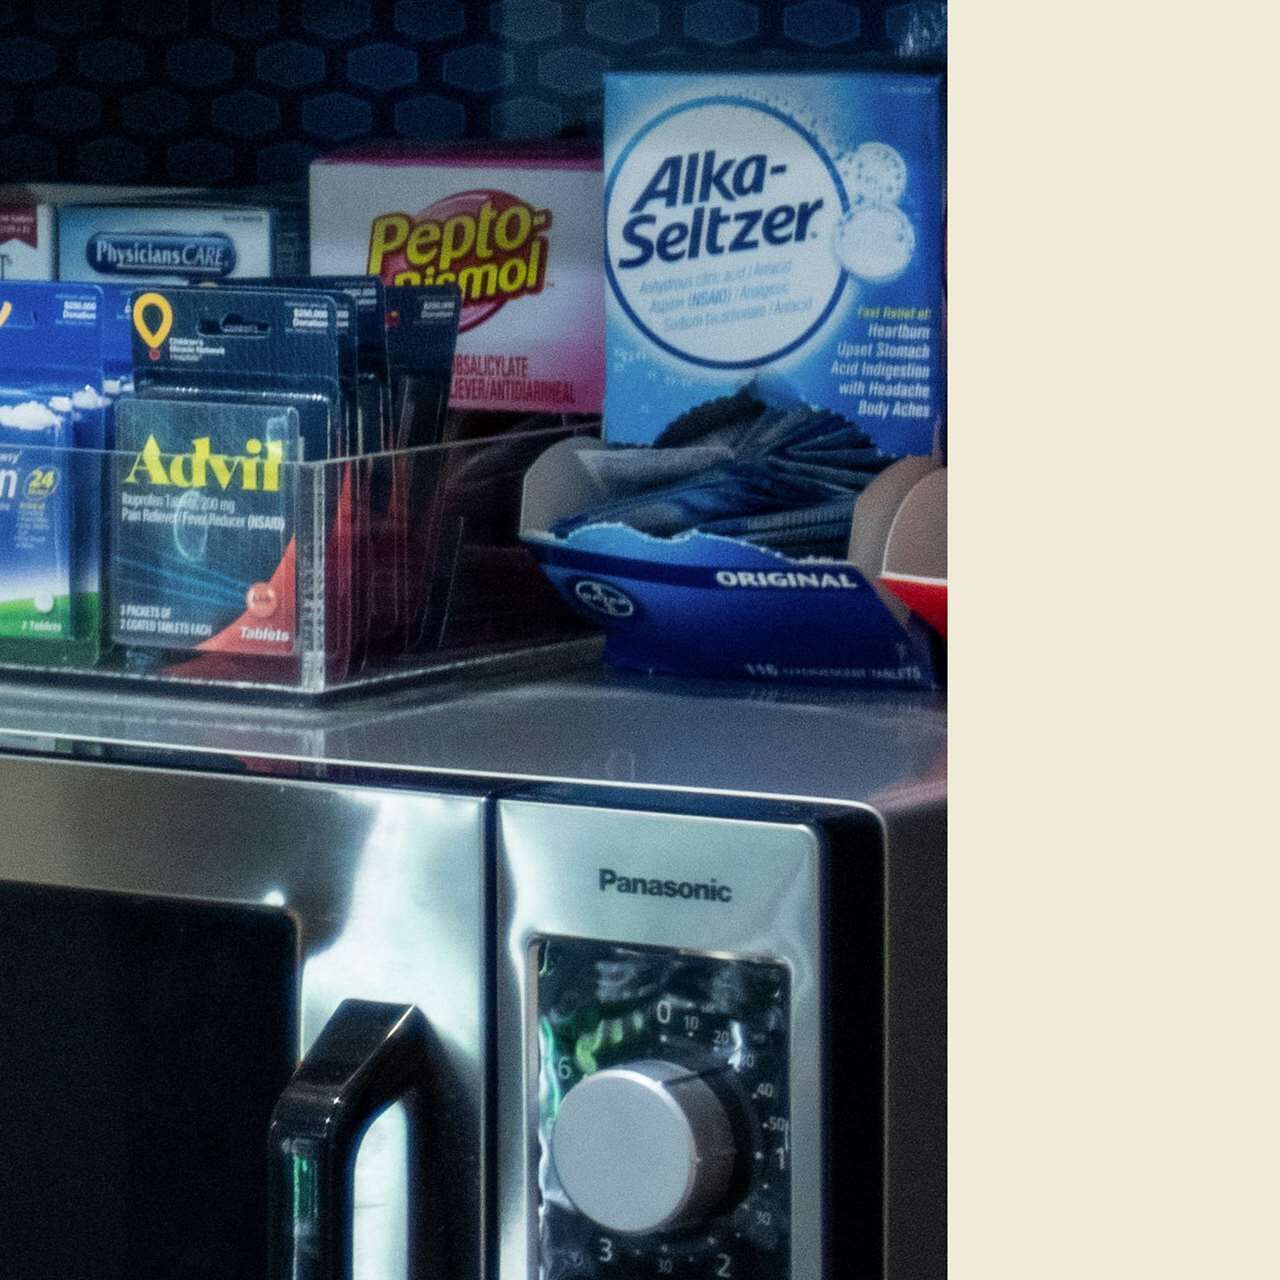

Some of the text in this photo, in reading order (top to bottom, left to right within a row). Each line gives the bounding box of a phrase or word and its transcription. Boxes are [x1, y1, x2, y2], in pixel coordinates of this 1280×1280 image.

[629, 149, 788, 216] Alka-
[618, 197, 826, 270] Seltzer
[95, 241, 230, 269] PhysiciansCARE
[868, 323, 931, 340] Heartburn
[837, 341, 931, 359] Upset Stomach
[831, 361, 931, 380] Acid Indigestion
[839, 381, 931, 399] with Headache
[857, 400, 931, 419] Body Aches
[126, 434, 284, 492] Advil
[29, 469, 55, 488] 24
[714, 569, 859, 590] ORIGINAL
[240, 626, 290, 642] Tablets
[598, 867, 733, 904] Panasonic
[656, 1000, 672, 1025] 0
[683, 1015, 700, 1031] 10
[557, 1060, 572, 1080] 6
[755, 1082, 774, 1100] 40
[775, 1146, 786, 1171] 1
[599, 1237, 614, 1263] 3
[716, 1253, 733, 1278] 2
